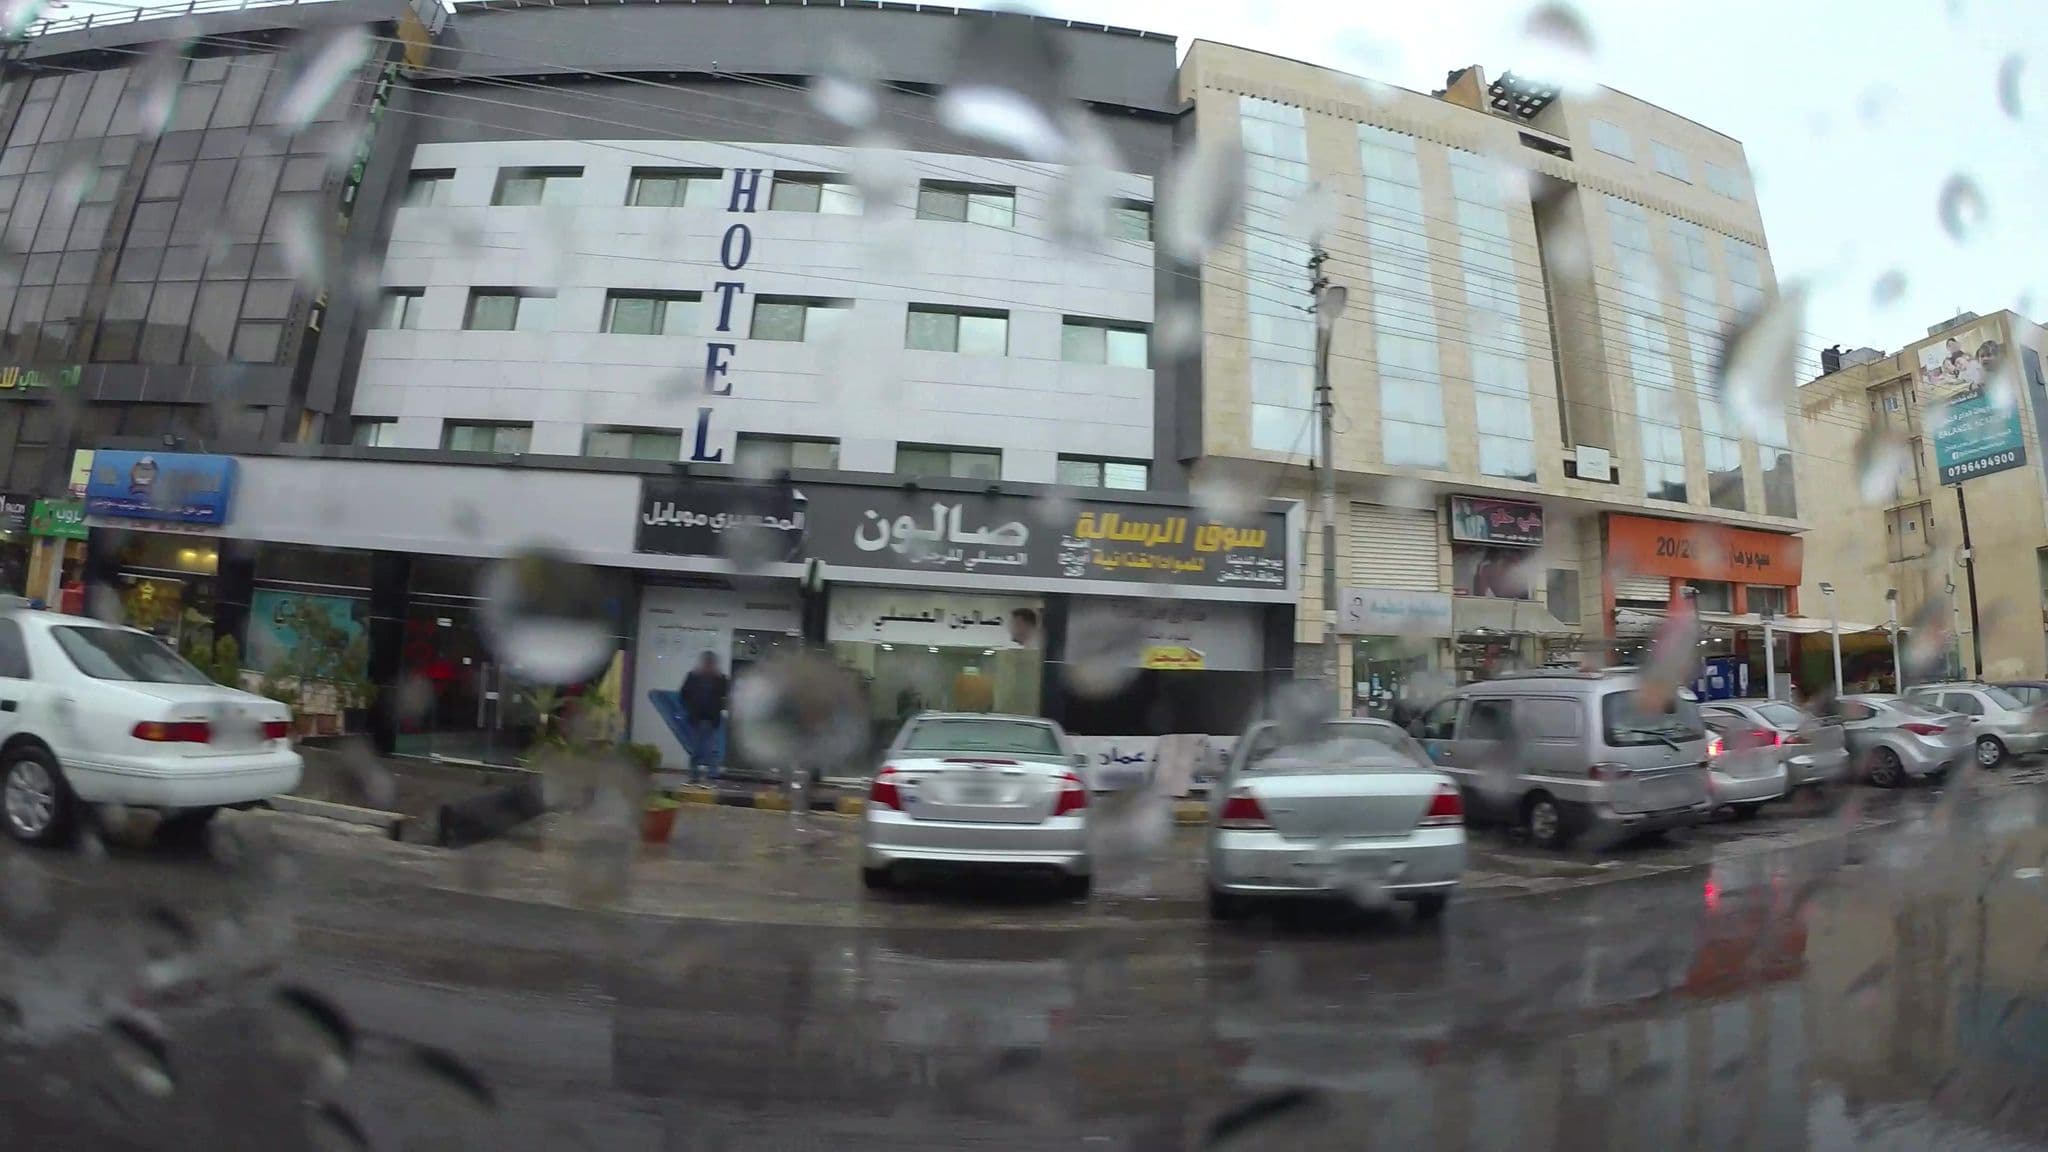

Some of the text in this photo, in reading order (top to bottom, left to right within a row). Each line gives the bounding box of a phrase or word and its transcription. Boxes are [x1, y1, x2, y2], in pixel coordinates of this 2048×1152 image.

[691, 167, 762, 461] HOTEL
[1948, 451, 2015, 477] 0796494900
[643, 501, 708, 527] موبايل
[853, 502, 1029, 551] صالون
[1075, 511, 1267, 552] سوق الرسالة
